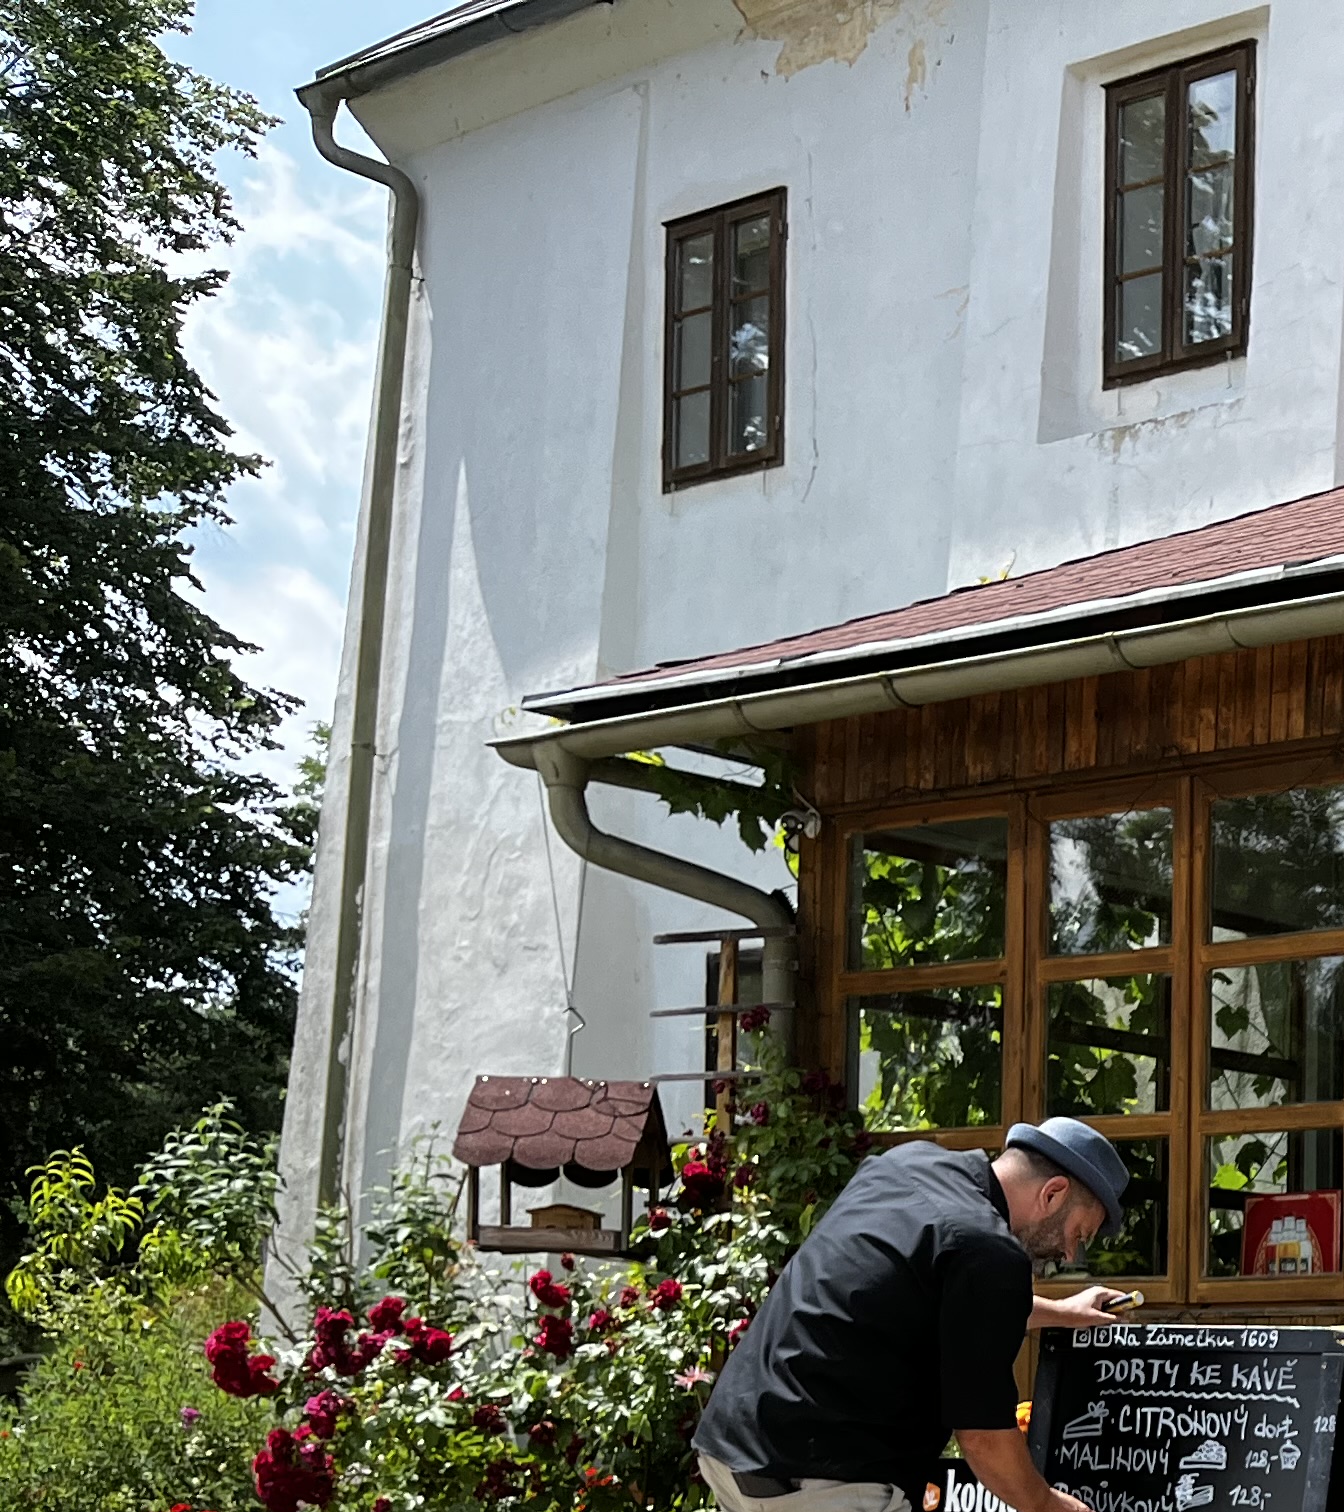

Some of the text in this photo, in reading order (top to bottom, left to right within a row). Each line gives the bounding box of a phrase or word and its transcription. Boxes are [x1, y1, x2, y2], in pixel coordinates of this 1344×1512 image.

[1240, 1328, 1279, 1349] 1609
[1095, 1358, 1298, 1391] DORTY KE KÁVĚ
